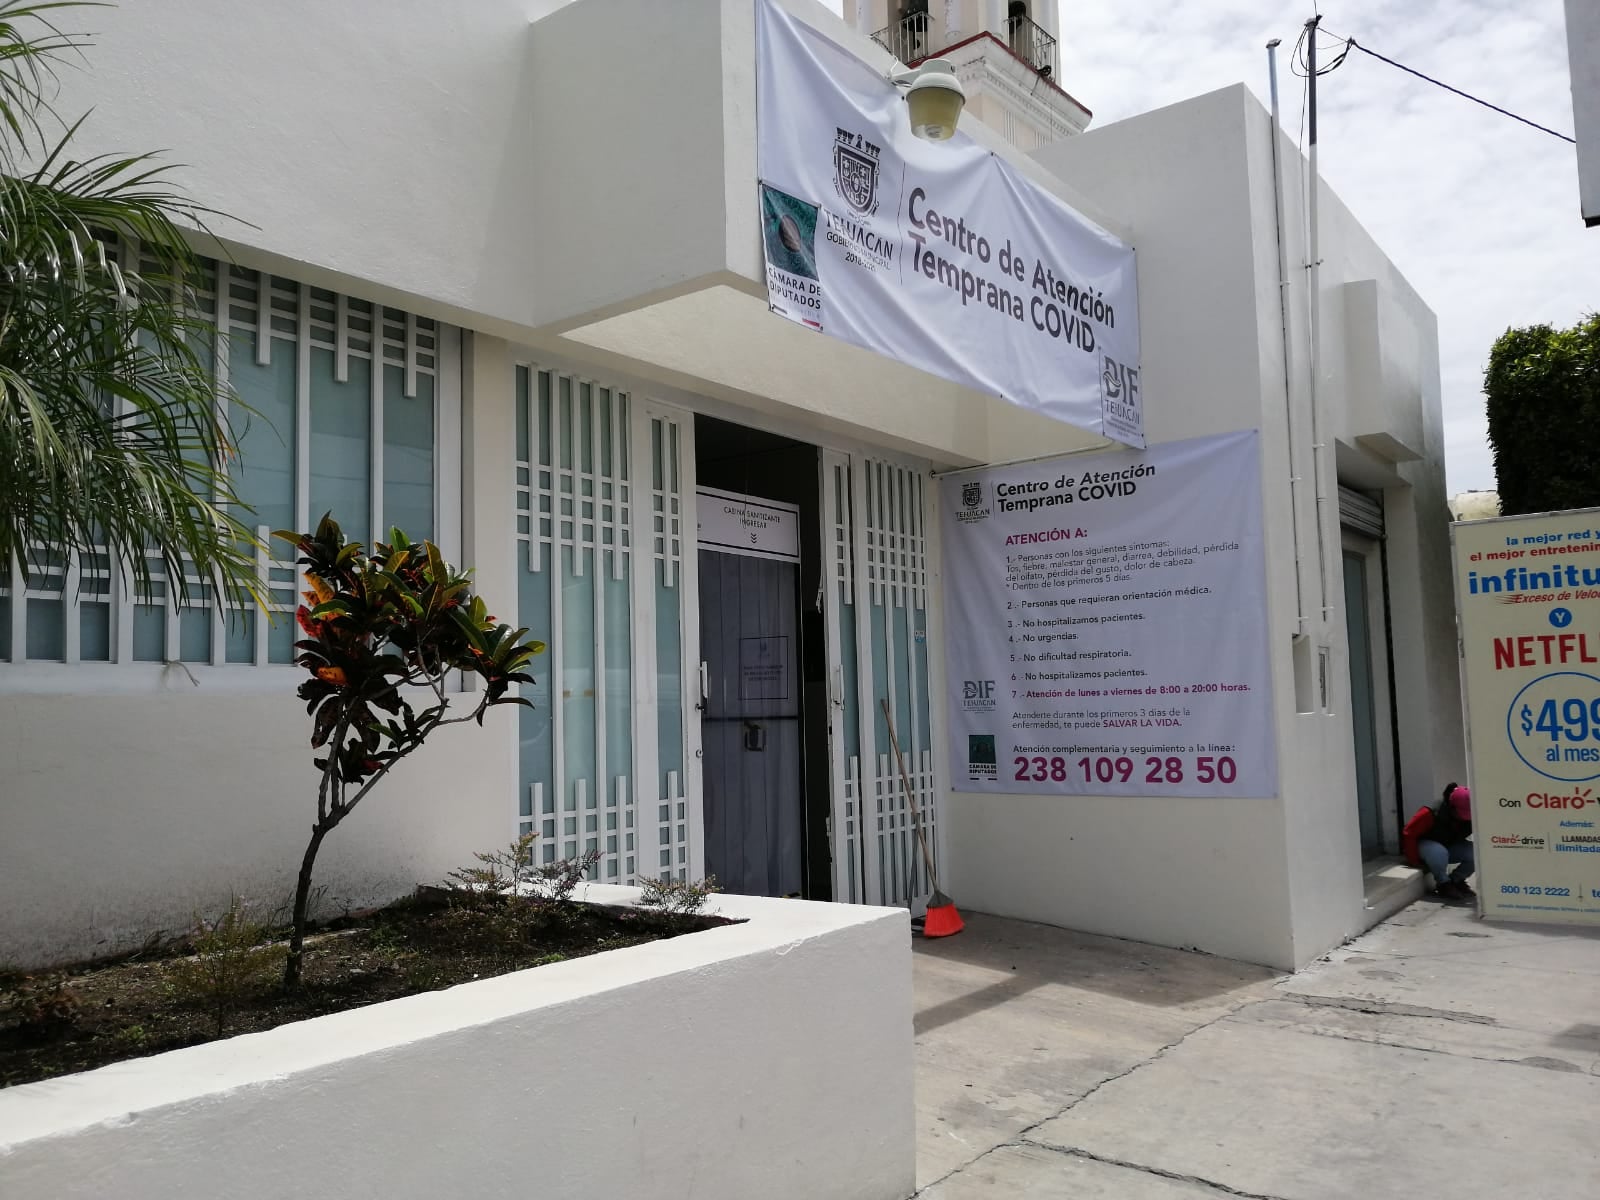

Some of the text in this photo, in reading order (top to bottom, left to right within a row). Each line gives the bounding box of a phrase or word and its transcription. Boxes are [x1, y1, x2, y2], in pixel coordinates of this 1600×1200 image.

[908, 188, 1115, 328] Centro de Atención
[769, 281, 821, 310] DIPUTADOS
[809, 284, 821, 296] DE
[908, 231, 1095, 352] Temprana COVID
[1103, 355, 1138, 407] DIF
[997, 465, 1156, 497] Centro de Atención
[998, 481, 1137, 513] Temprana COVID
[1005, 528, 1088, 545] ATENCIÓN A:
[1506, 536, 1519, 546] la
[1523, 533, 1563, 544] mejor
[1567, 529, 1591, 540] red
[1018, 554, 1053, 562] Personas
[1055, 551, 1070, 559] con
[1071, 549, 1083, 557] los
[1085, 545, 1127, 557] siguientes
[1470, 552, 1482, 561] el
[1486, 549, 1526, 560] mejor
[1006, 574, 1019, 582] del
[1081, 567, 1094, 575] del
[1124, 562, 1147, 571] dolor
[1149, 560, 1160, 568] de
[1041, 580, 1051, 588] de
[1053, 579, 1065, 587] los
[1067, 576, 1104, 587] primeros
[1105, 574, 1111, 582] 5
[1021, 600, 1058, 608] Personas
[1060, 598, 1076, 607] que
[1078, 594, 1119, 606] requieran
[1122, 589, 1171, 601] orientación
[1175, 586, 1212, 596] médica.
[1514, 592, 1555, 604] Exceso
[1557, 591, 1572, 600] de
[1022, 619, 1035, 628] No
[1037, 616, 1099, 629] hospitalizamos
[1101, 613, 1146, 625] pacientes.
[1555, 612, 1566, 624] Y
[1022, 634, 1035, 642] No
[1037, 632, 1080, 643] urgencias.
[1023, 653, 1036, 662] No
[1038, 651, 1077, 662] dificultad
[1079, 649, 1132, 661] respiratoria.
[1493, 633, 1600, 670] NETFL
[1025, 672, 1037, 681] No
[1039, 670, 1101, 682] hospitalizamos
[1103, 669, 1149, 680] pacientes.
[963, 680, 996, 699] DIF
[1026, 689, 1062, 698] Atención
[1064, 688, 1076, 697] de
[1078, 688, 1100, 697] lunes
[1110, 686, 1142, 696] viernes
[1145, 685, 1157, 695] de
[1160, 685, 1181, 694] 8:00
[1191, 683, 1218, 693] 20:00
[1220, 683, 1251, 692] horas.
[1053, 710, 1085, 719] durante
[1086, 709, 1099, 718] los
[1100, 709, 1138, 720] primeros
[1140, 708, 1146, 717] 3
[1169, 707, 1181, 717] de
[1183, 707, 1191, 716] la
[1063, 721, 1072, 729] te
[1074, 720, 1101, 731] puede
[1103, 719, 1138, 728] SALVAR
[1140, 719, 1153, 728] LA
[1155, 718, 1182, 727] VIDA.
[1012, 745, 1050, 753] Atención
[1052, 744, 1120, 756] complementaria
[1122, 746, 1128, 755] y
[1129, 744, 1186, 755] seguimiento
[1188, 745, 1194, 753] a
[1197, 743, 1206, 752] la
[1546, 743, 1600, 762] al mes
[1014, 756, 1237, 784] 238 109 28 50
[1499, 798, 1521, 808] Con
[1501, 885, 1570, 897] 800 123 2222
